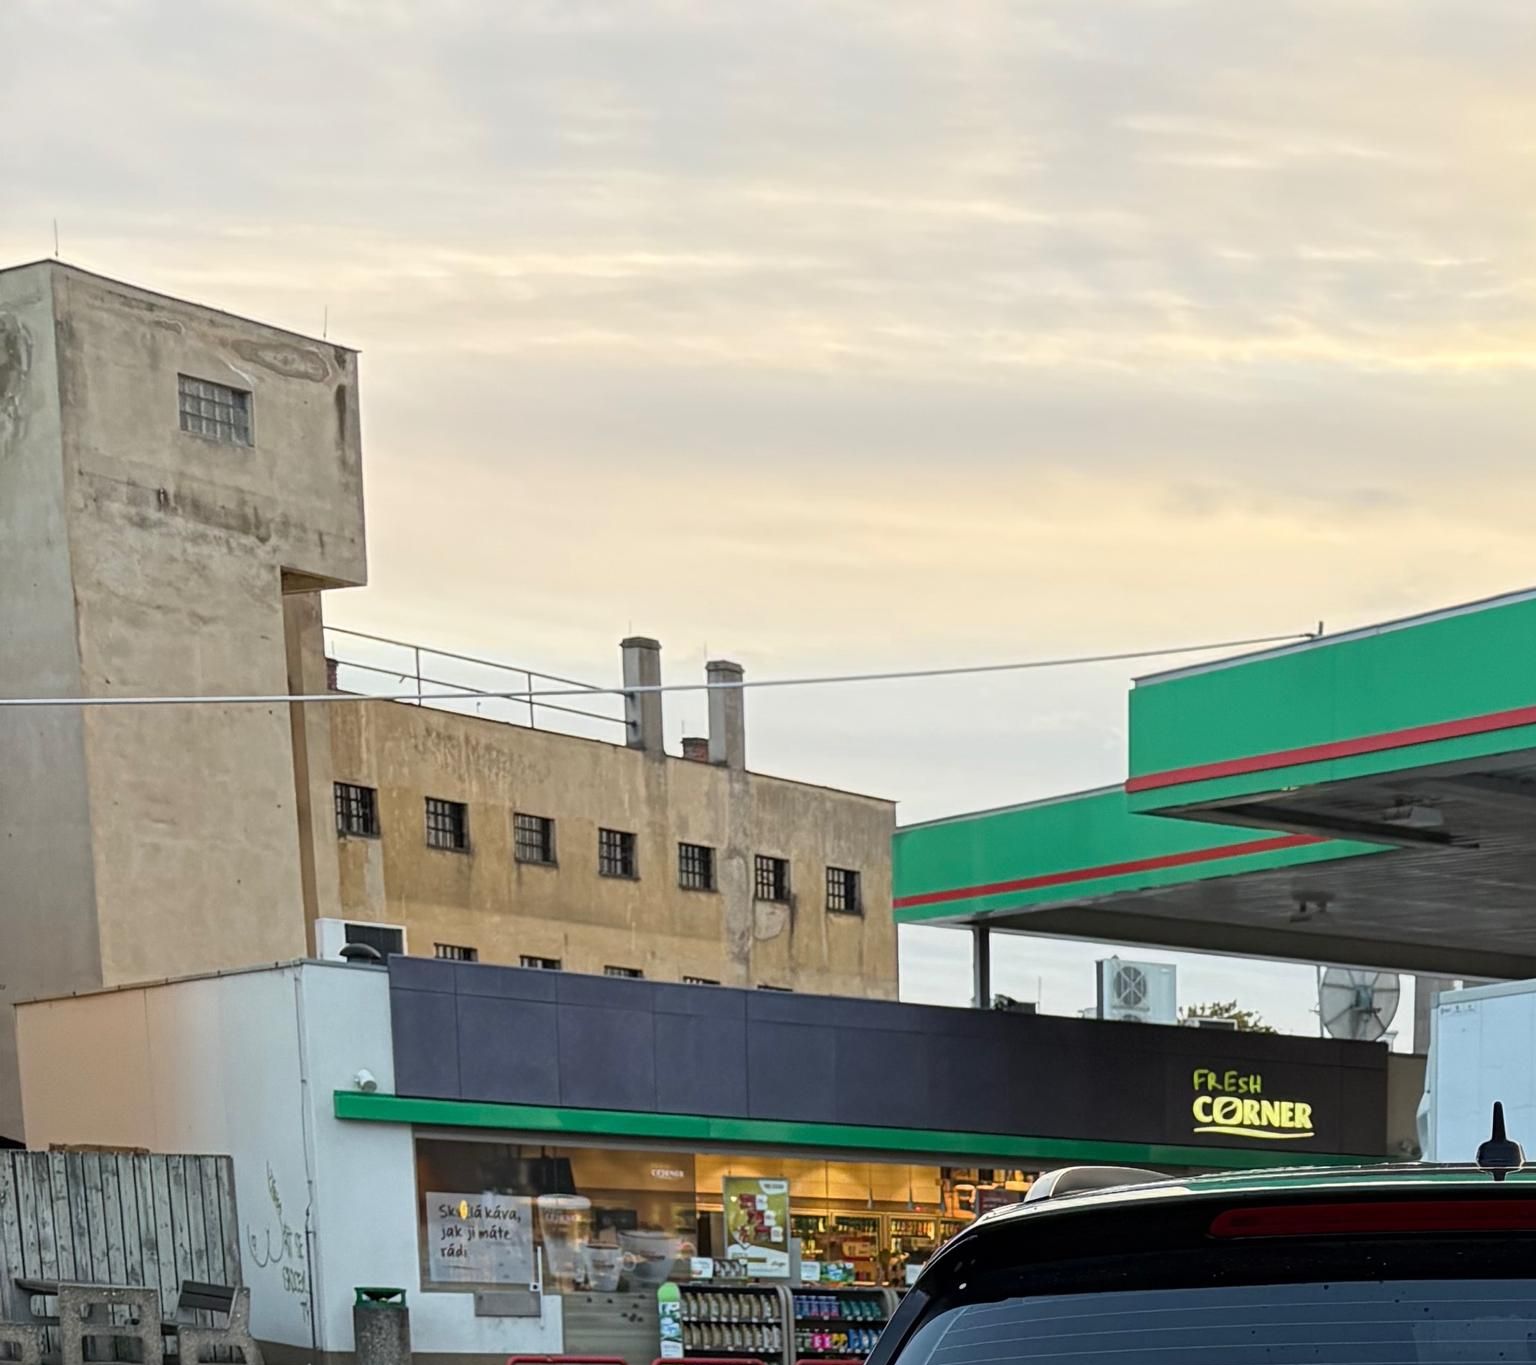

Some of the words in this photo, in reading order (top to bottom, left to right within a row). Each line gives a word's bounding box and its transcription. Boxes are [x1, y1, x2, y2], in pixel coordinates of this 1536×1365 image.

[1193, 1069, 1262, 1094] FRESH
[1192, 1095, 1313, 1129] CORNER
[485, 1205, 522, 1222] káva,
[440, 1224, 462, 1241] jak
[478, 1224, 512, 1240] máte
[440, 1243, 467, 1259] rádi
